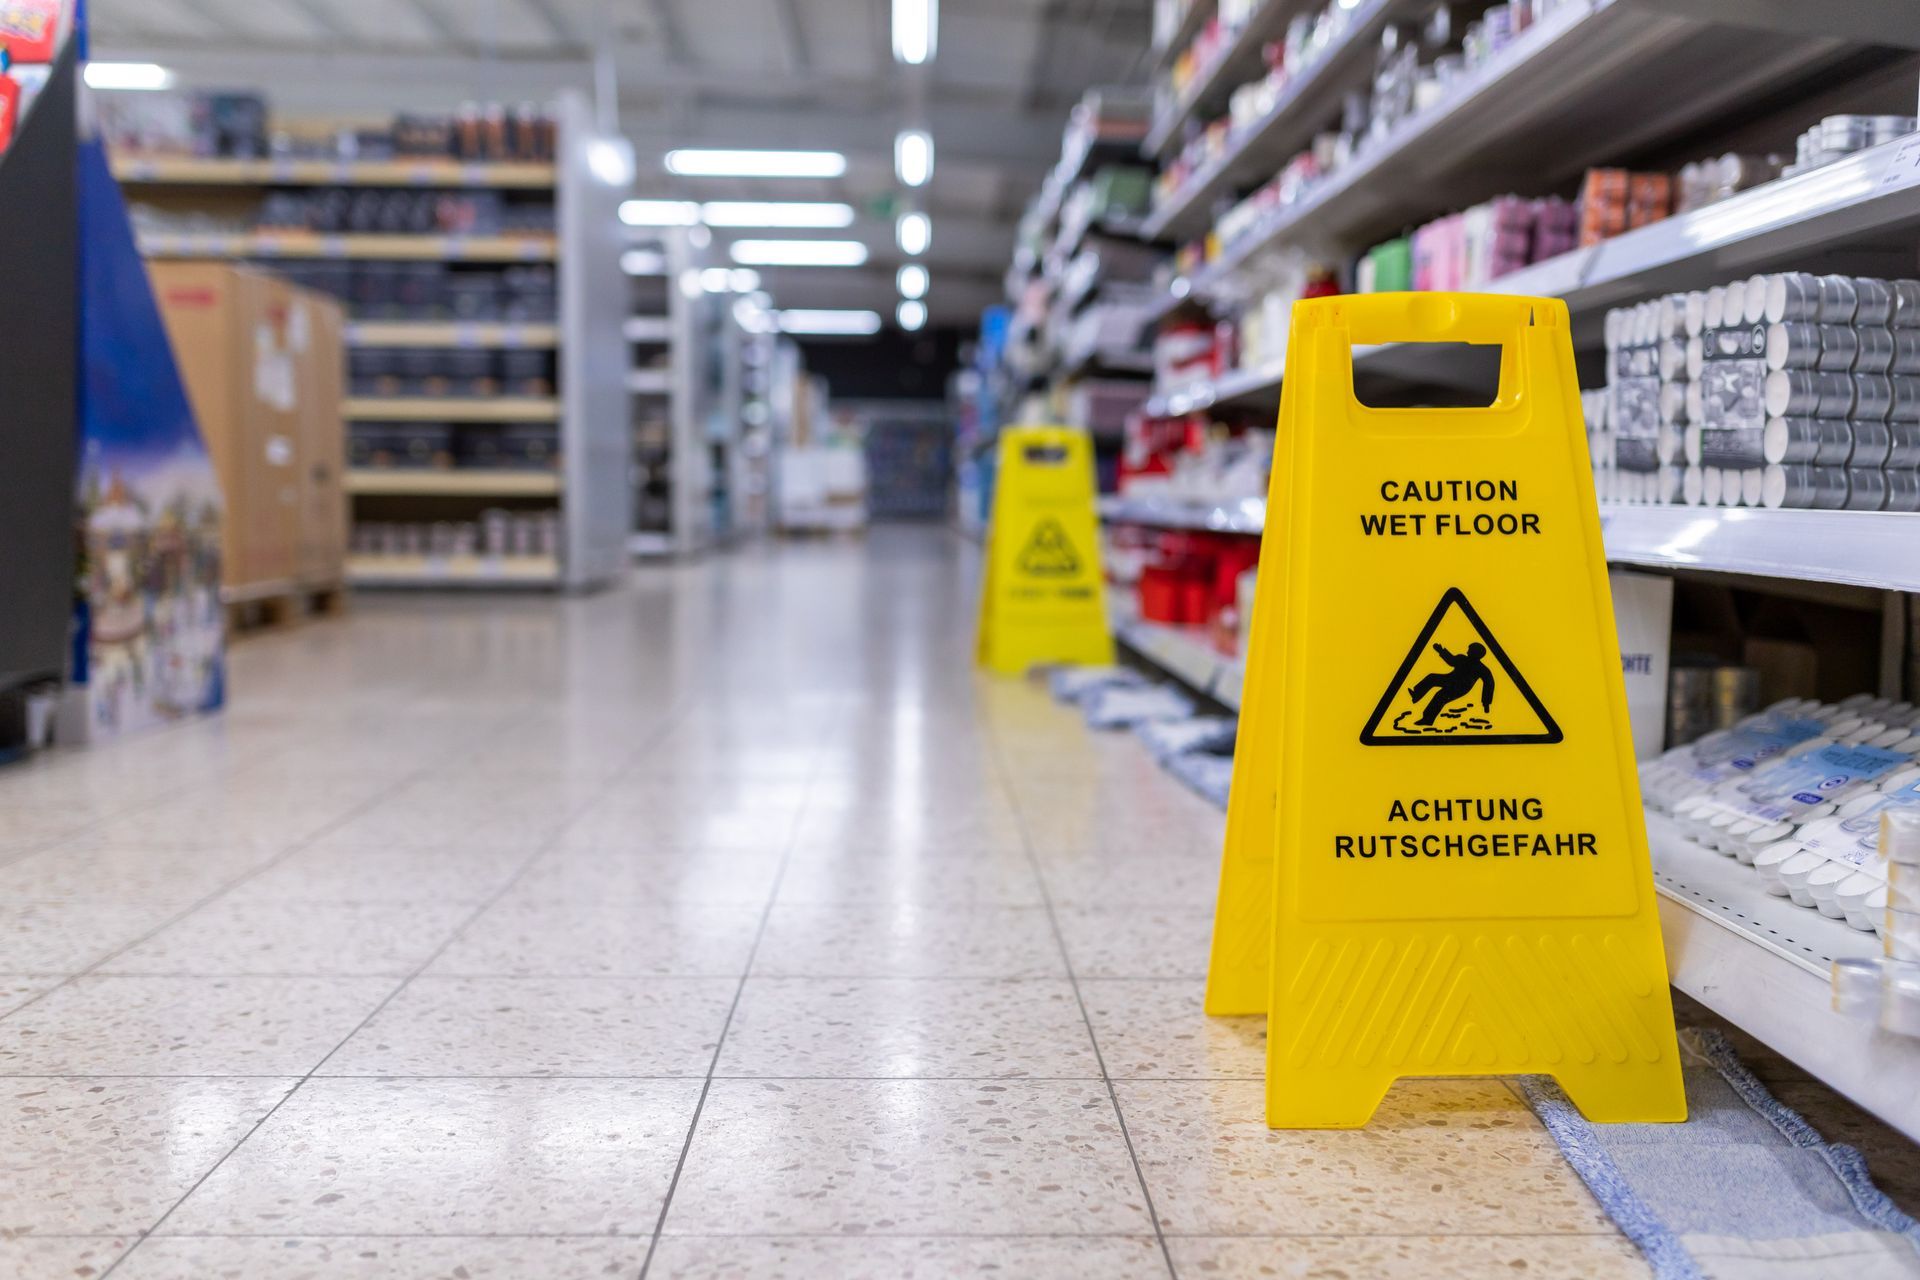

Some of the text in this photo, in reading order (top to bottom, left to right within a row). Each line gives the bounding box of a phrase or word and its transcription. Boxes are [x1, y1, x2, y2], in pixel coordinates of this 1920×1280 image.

[1380, 479, 1518, 502] CAUTION
[1360, 513, 1541, 536] WET FLOOR
[1387, 797, 1543, 822] ACHTUNG
[1335, 833, 1598, 859] RUTSCHGEFAHR
